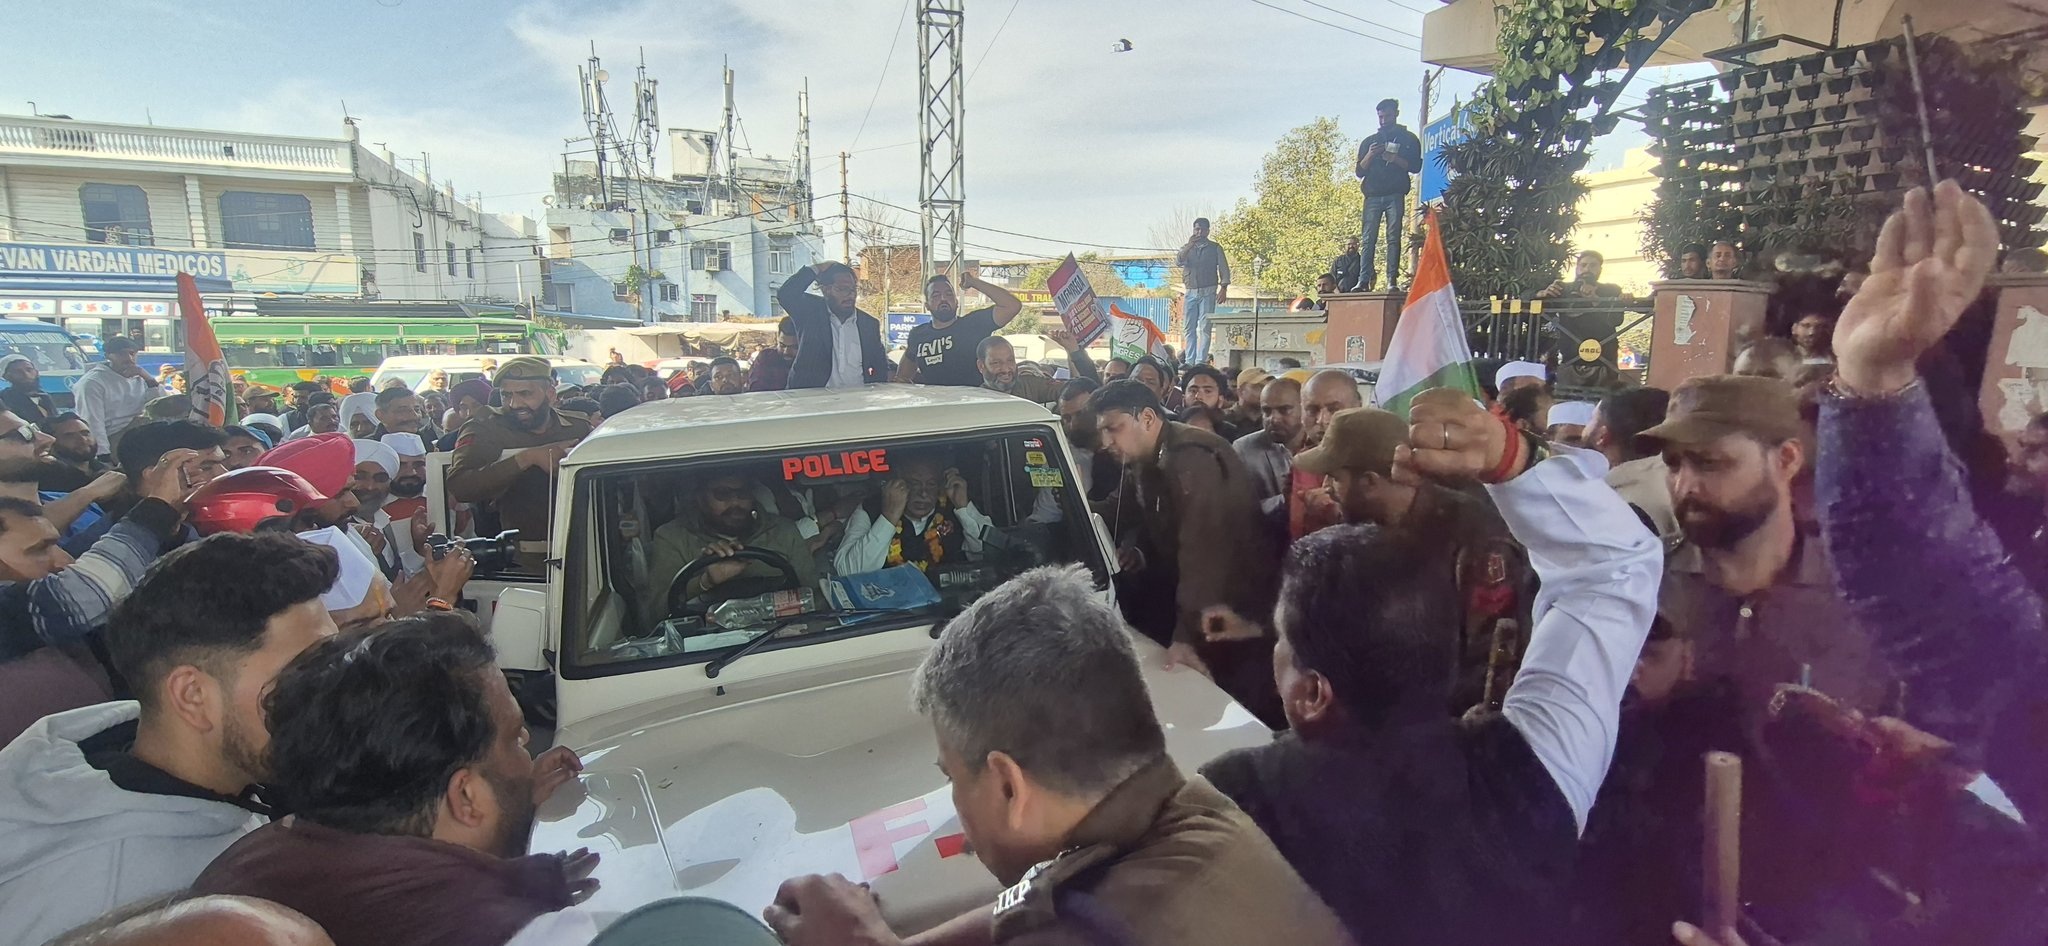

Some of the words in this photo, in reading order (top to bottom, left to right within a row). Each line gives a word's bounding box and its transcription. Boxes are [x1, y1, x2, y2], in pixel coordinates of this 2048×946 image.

[1424, 114, 1461, 154] Vertical
[51, 249, 133, 274] VARDAN
[137, 252, 223, 277] MEDICOS
[1014, 292, 1030, 302] OL
[903, 315, 916, 323] NO
[916, 335, 953, 358] LEVI'S
[782, 448, 890, 480] POLICE
